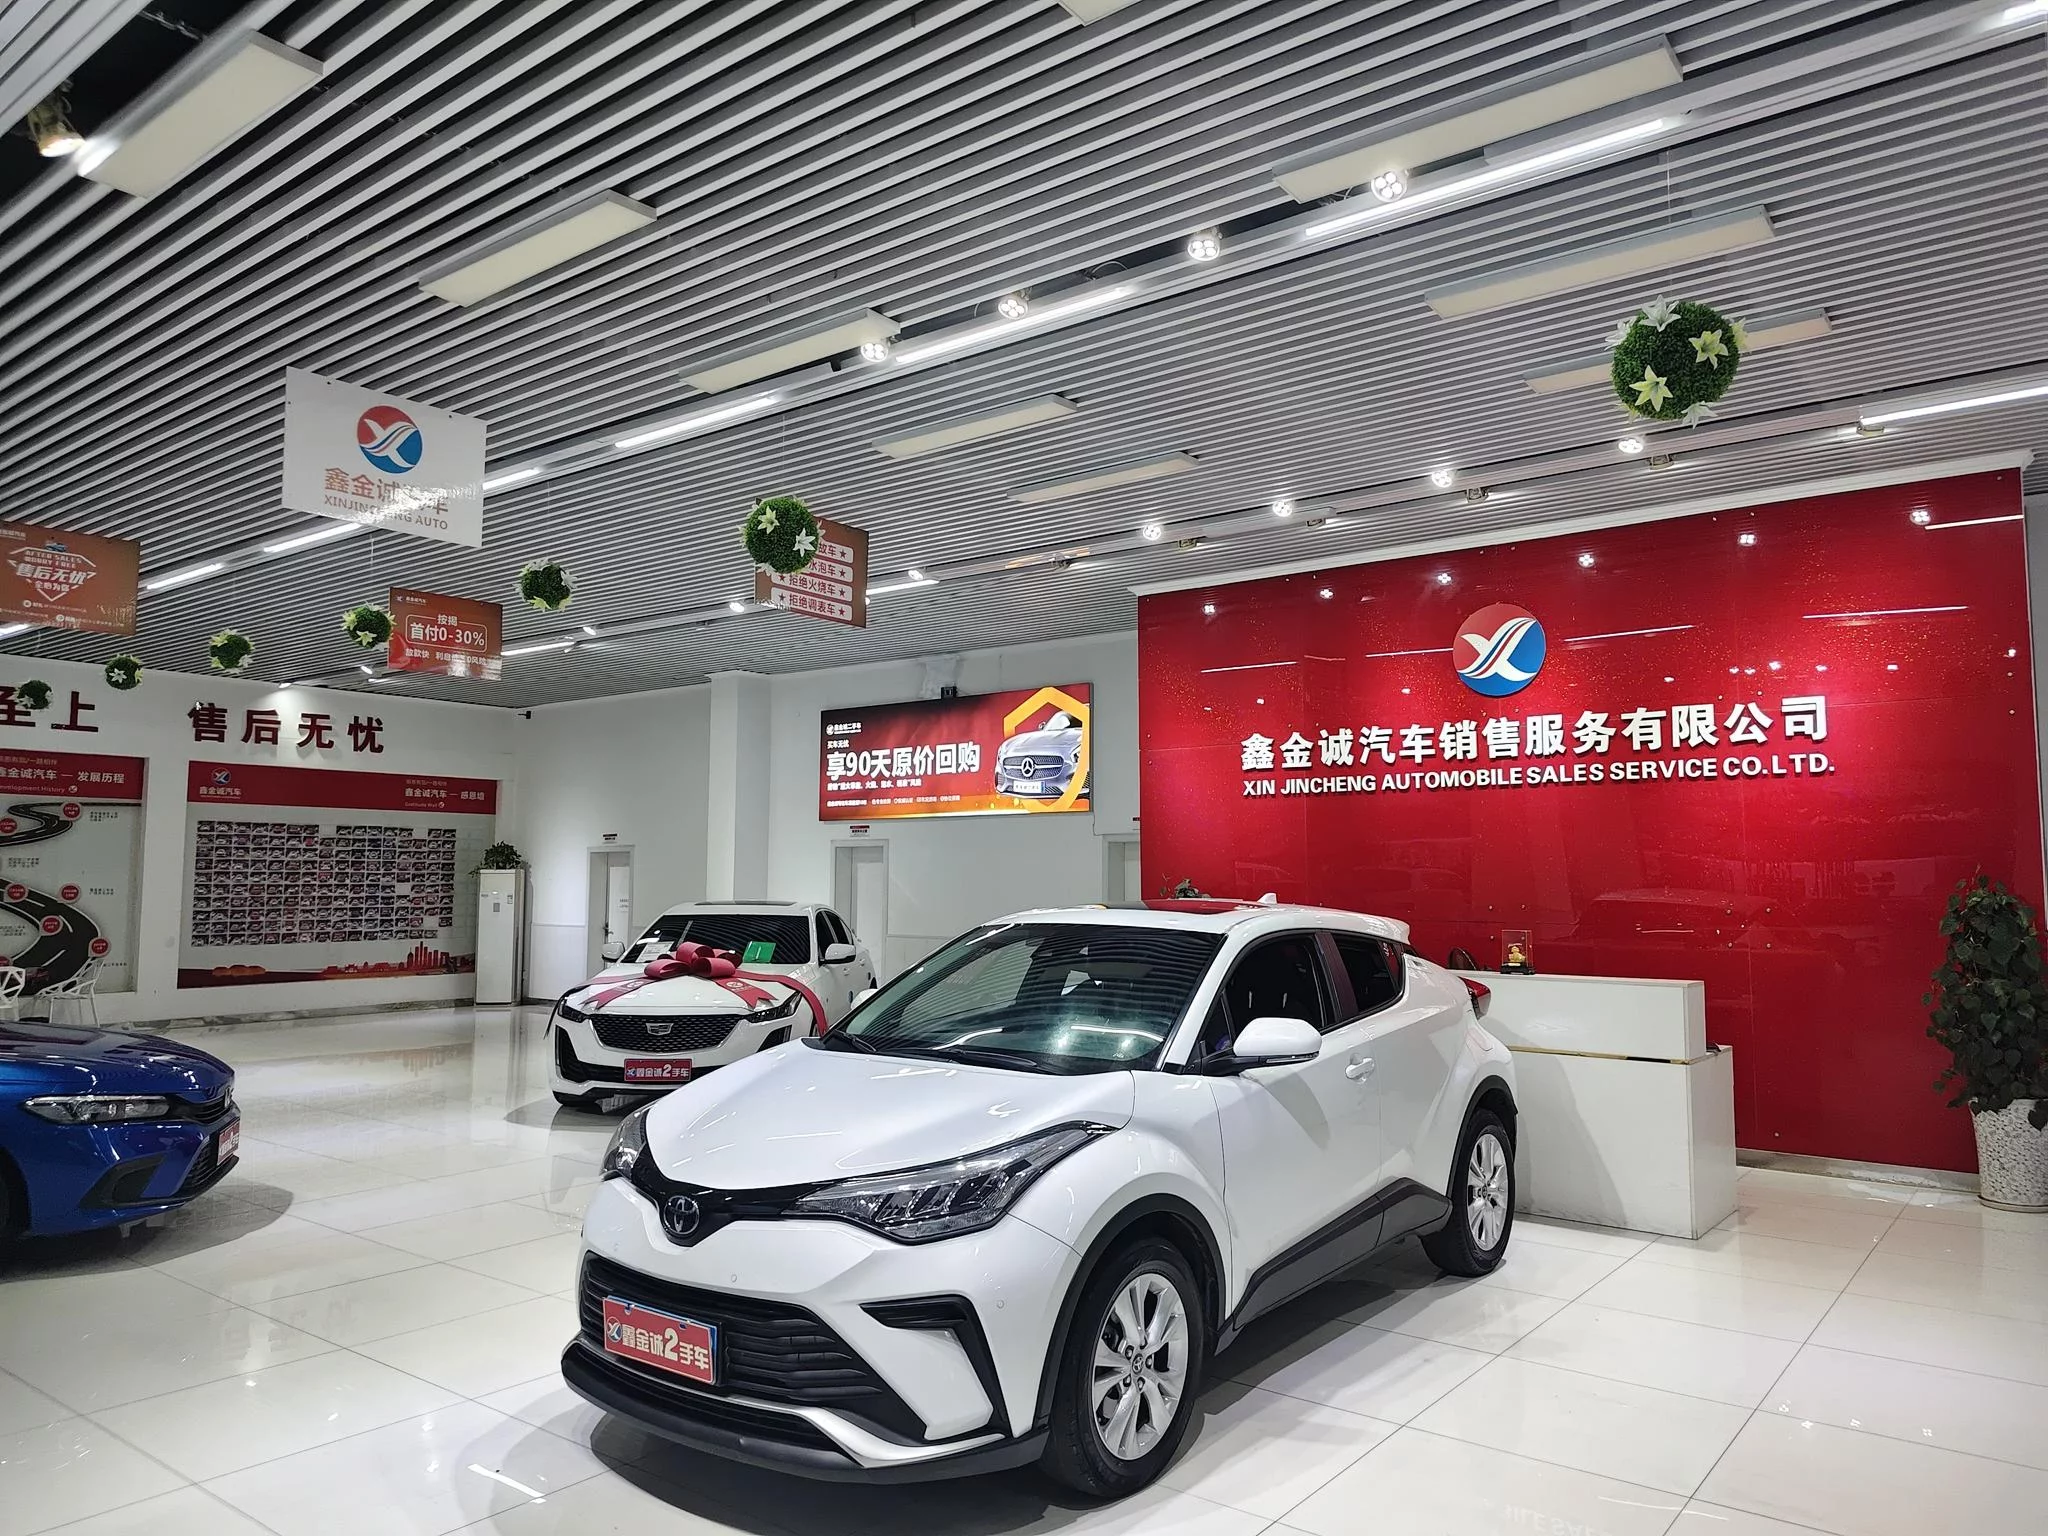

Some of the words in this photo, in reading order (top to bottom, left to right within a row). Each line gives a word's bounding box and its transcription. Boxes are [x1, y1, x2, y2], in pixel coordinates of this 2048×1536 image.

[325, 467, 448, 514] 鑫金诚车
[325, 495, 412, 522] XINJINCNG
[416, 515, 448, 530] AUTO
[16, 563, 87, 585] 售后无忧
[789, 574, 836, 596] 拒绝火烧车
[437, 614, 458, 626] 按揭
[789, 594, 836, 616] 拒绝调表车
[410, 622, 485, 646] 首付0-30%
[187, 702, 385, 754] 售后无忧
[1241, 695, 1829, 772] 鑫金诚汽车销售服务有限公司
[78, 771, 125, 784] 发展历程
[826, 742, 981, 781] 享90天原价回购
[1243, 780, 1276, 796] XIN
[1280, 774, 1377, 795] JINCHENG
[1381, 767, 1524, 791] AUTOMOBILE
[1526, 762, 1606, 784] SALES
[1609, 757, 1719, 781] SERVICE
[622, 1324, 710, 1370] 鑫金诚2手车
